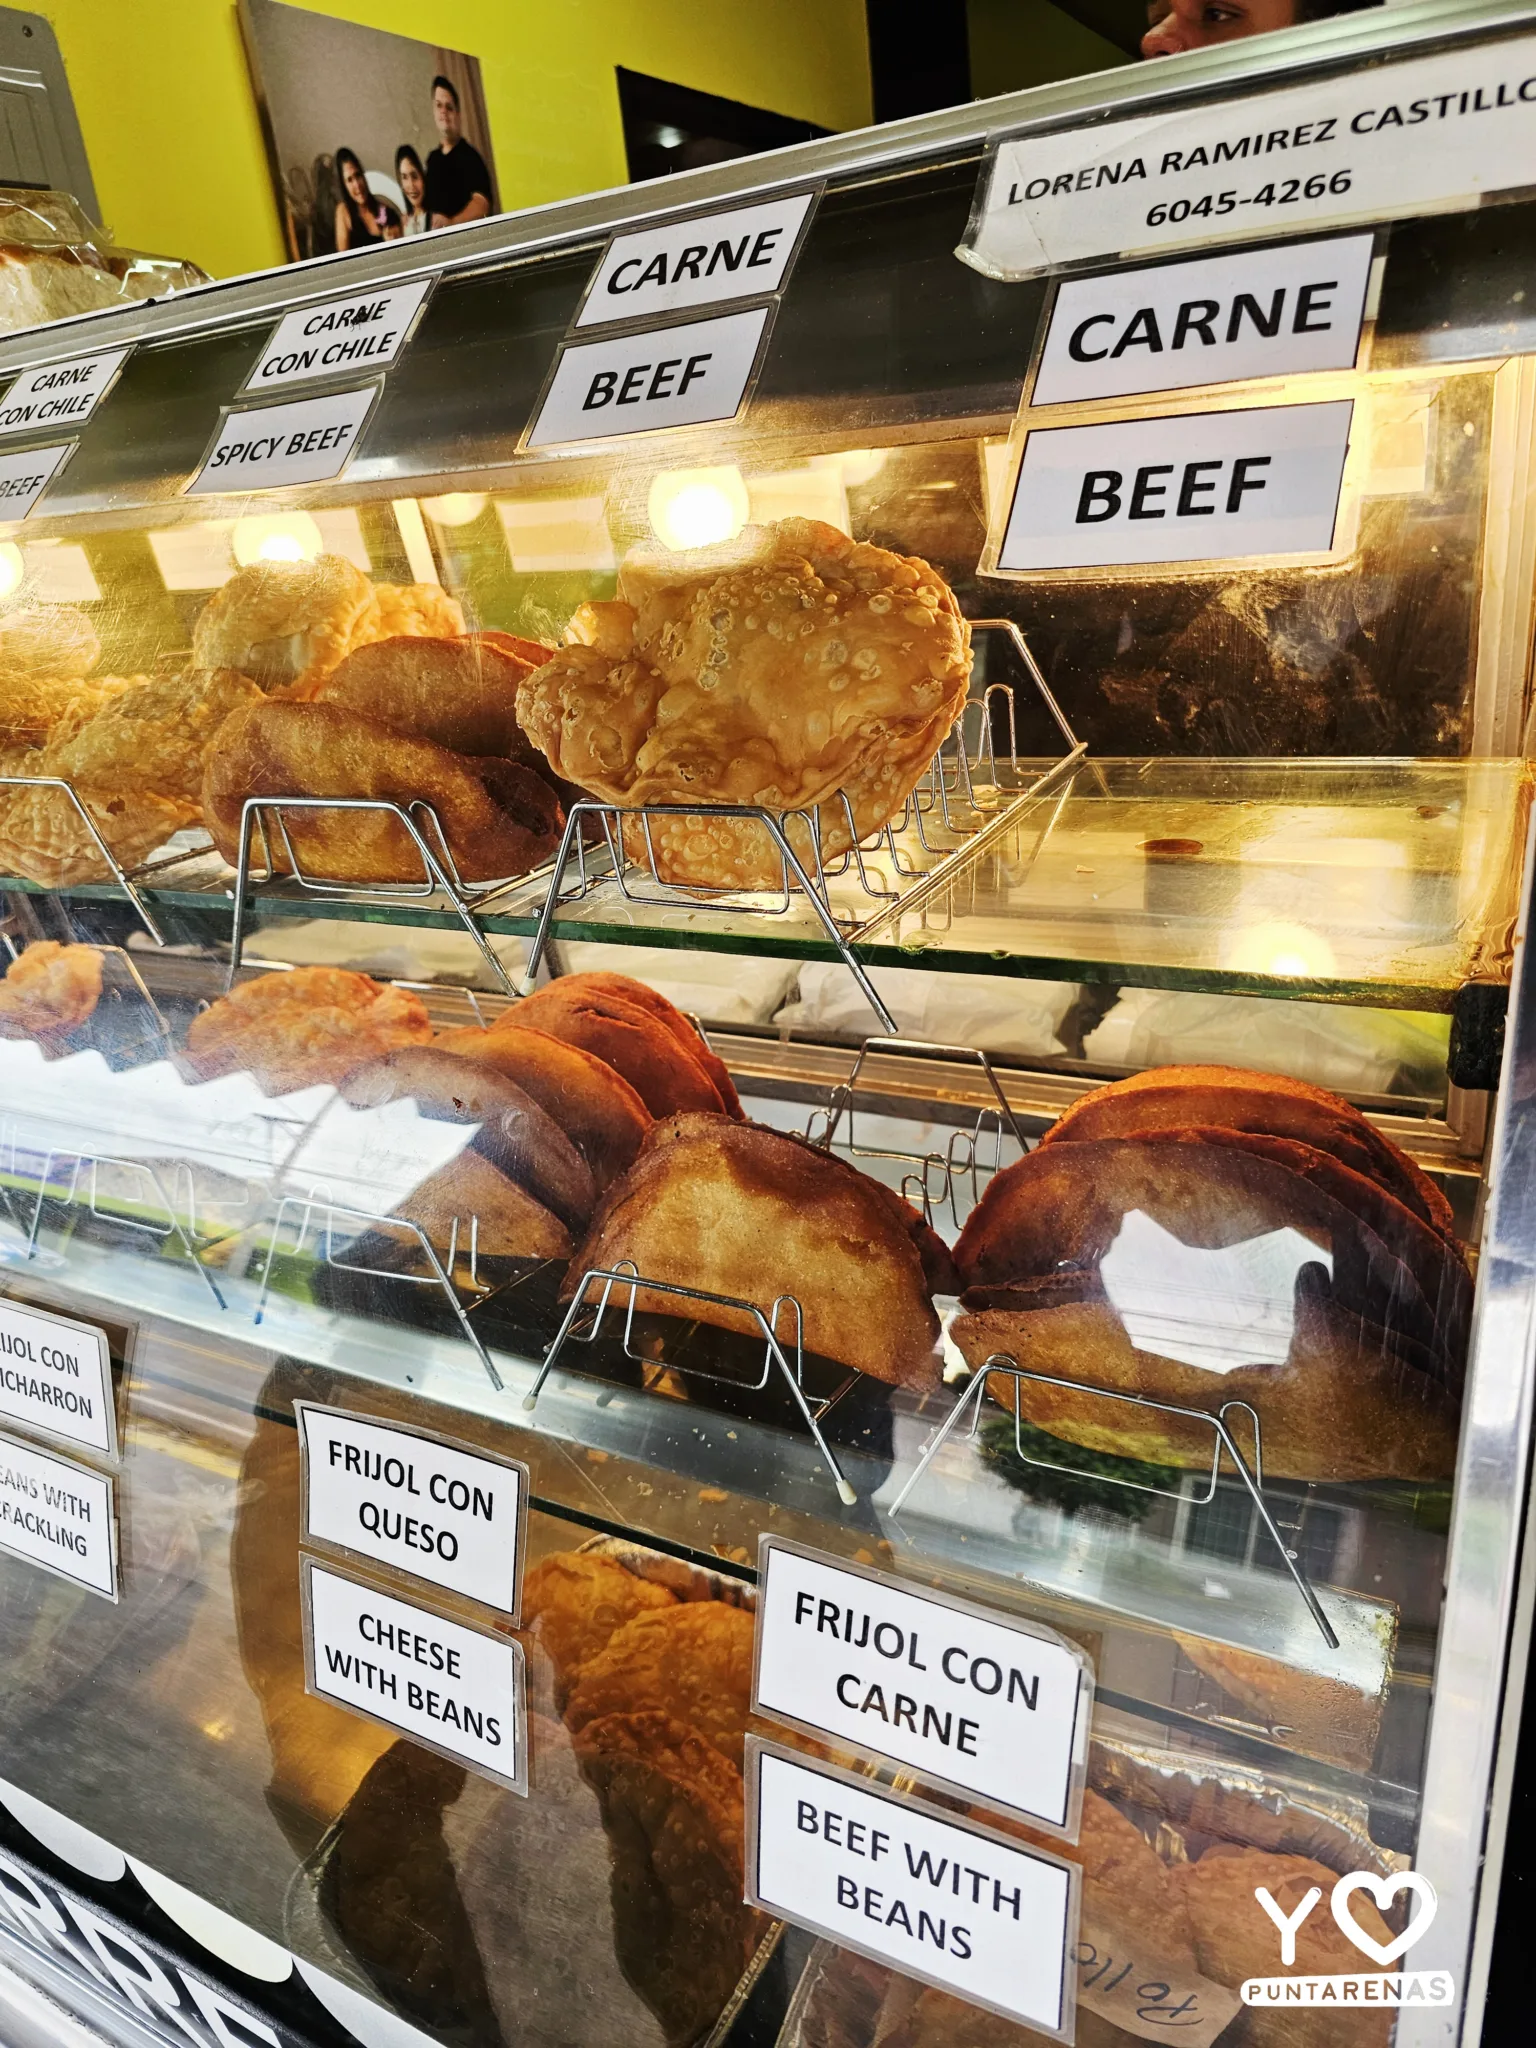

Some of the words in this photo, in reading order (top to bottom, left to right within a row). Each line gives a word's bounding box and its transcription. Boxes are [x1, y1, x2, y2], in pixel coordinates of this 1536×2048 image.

[1008, 158, 1146, 205] LORENA
[1160, 119, 1337, 174] RAMIREZ
[1147, 170, 1351, 226] 6045-4266
[608, 228, 783, 294] CARNE
[1069, 281, 1338, 362] CARNE
[31, 365, 97, 392] CARNE
[262, 349, 318, 377] CON
[322, 332, 397, 364] CHILE
[582, 353, 712, 410] BEEF
[38, 393, 94, 419] CHILE
[211, 436, 285, 467] SPICY
[286, 424, 352, 455] BEEF
[0, 475, 44, 497] BEEF
[1076, 456, 1271, 523] BEEF
[0, 1332, 37, 1362] IJOL
[41, 1347, 79, 1377] CON
[0, 1368, 92, 1418] ICHARRON
[42, 1482, 91, 1523] WITH
[329, 1440, 420, 1495] FRIJOL
[430, 1474, 493, 1521] CON
[360, 1502, 458, 1561] QUESO
[359, 1614, 460, 1679] CHEESE
[795, 1592, 926, 1671] FRIJOL
[942, 1648, 1039, 1711] CON
[325, 1645, 396, 1700] WITH
[408, 1681, 501, 1745] BEANS
[837, 1674, 979, 1756] CARNE
[798, 1800, 889, 1861] BEEF
[904, 1843, 1020, 1920] WITH
[838, 1875, 971, 1959] BEANS
